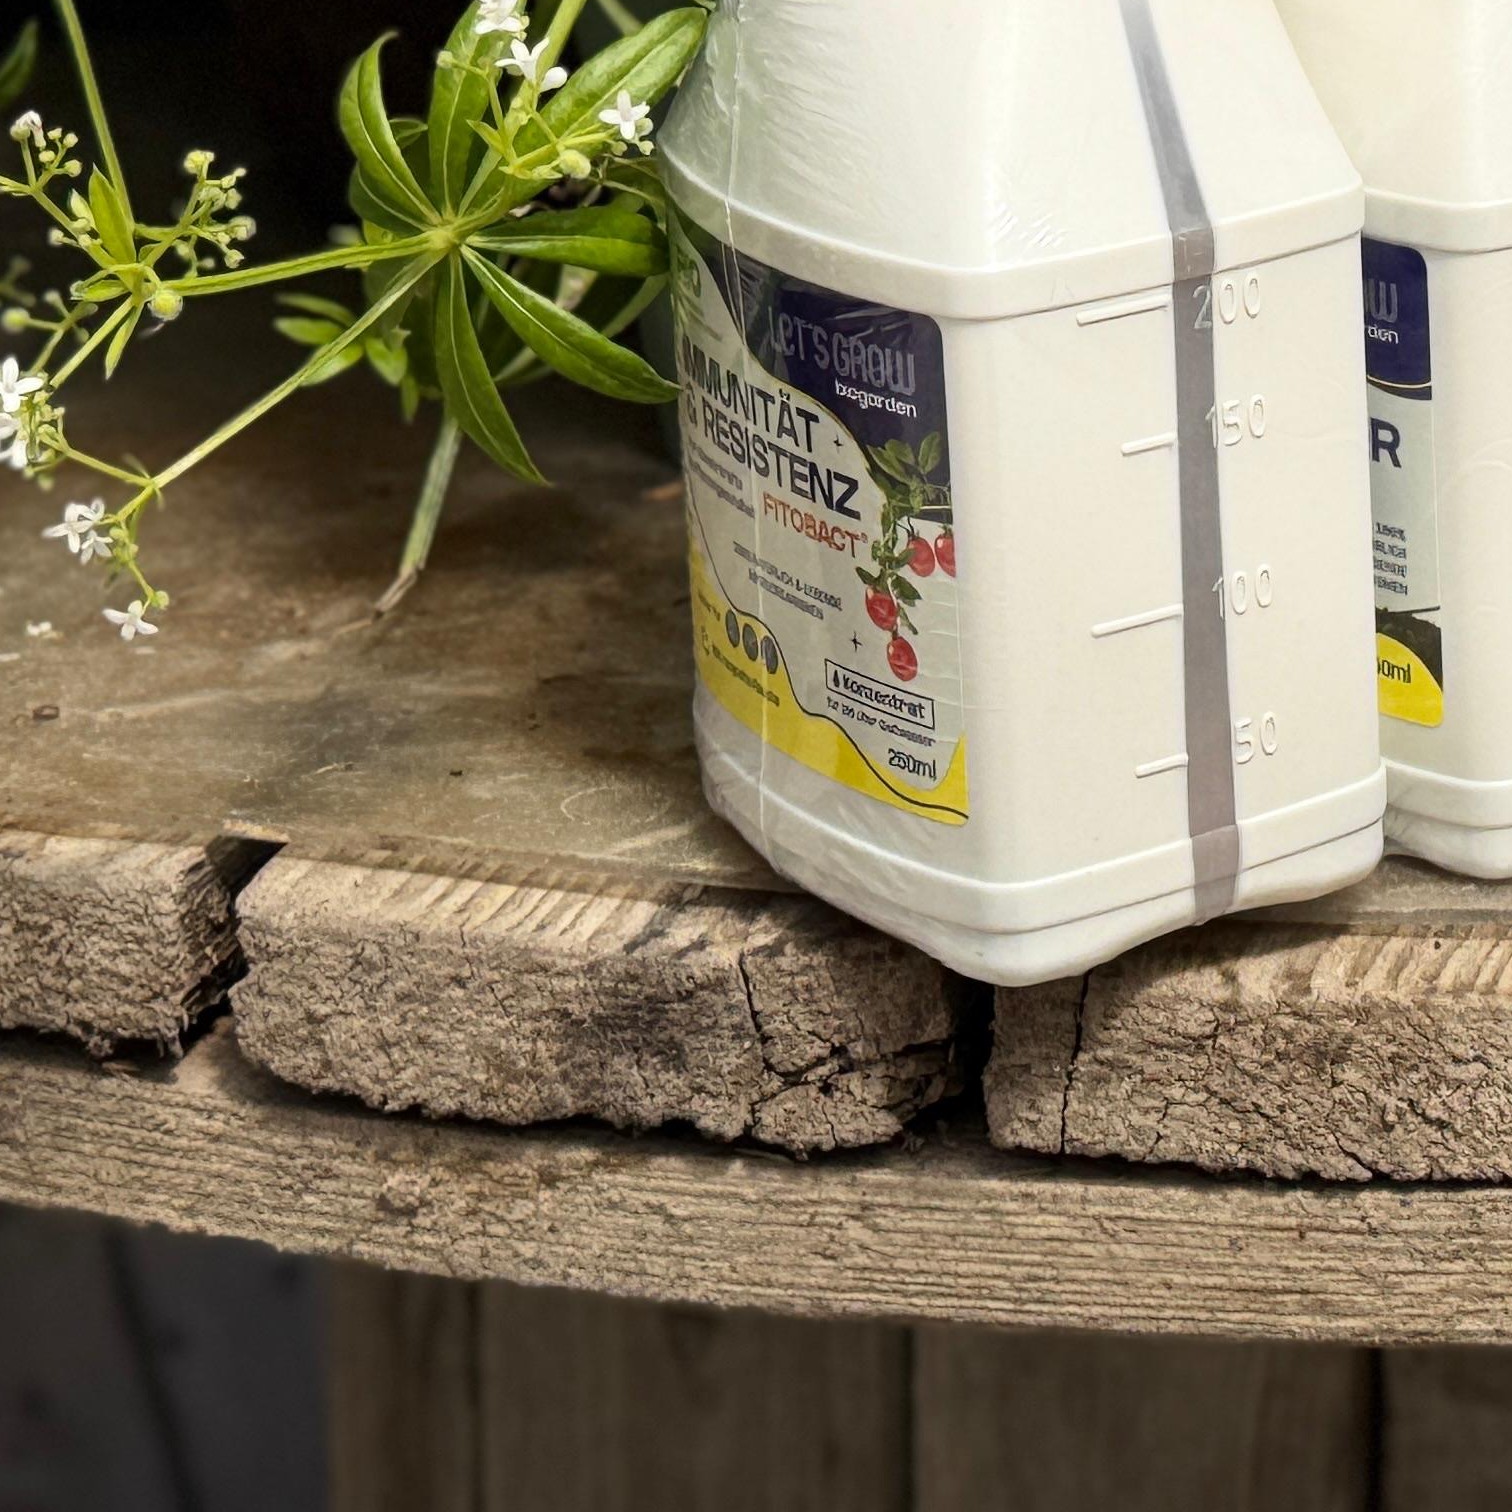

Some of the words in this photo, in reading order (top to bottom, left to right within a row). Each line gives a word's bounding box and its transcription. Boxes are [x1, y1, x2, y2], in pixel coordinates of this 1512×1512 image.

[1191, 270, 1262, 331] 200
[1204, 392, 1268, 449] 150
[701, 394, 862, 521] RESISTENZ
[1211, 562, 1275, 619] 100
[1233, 710, 1280, 765] 50
